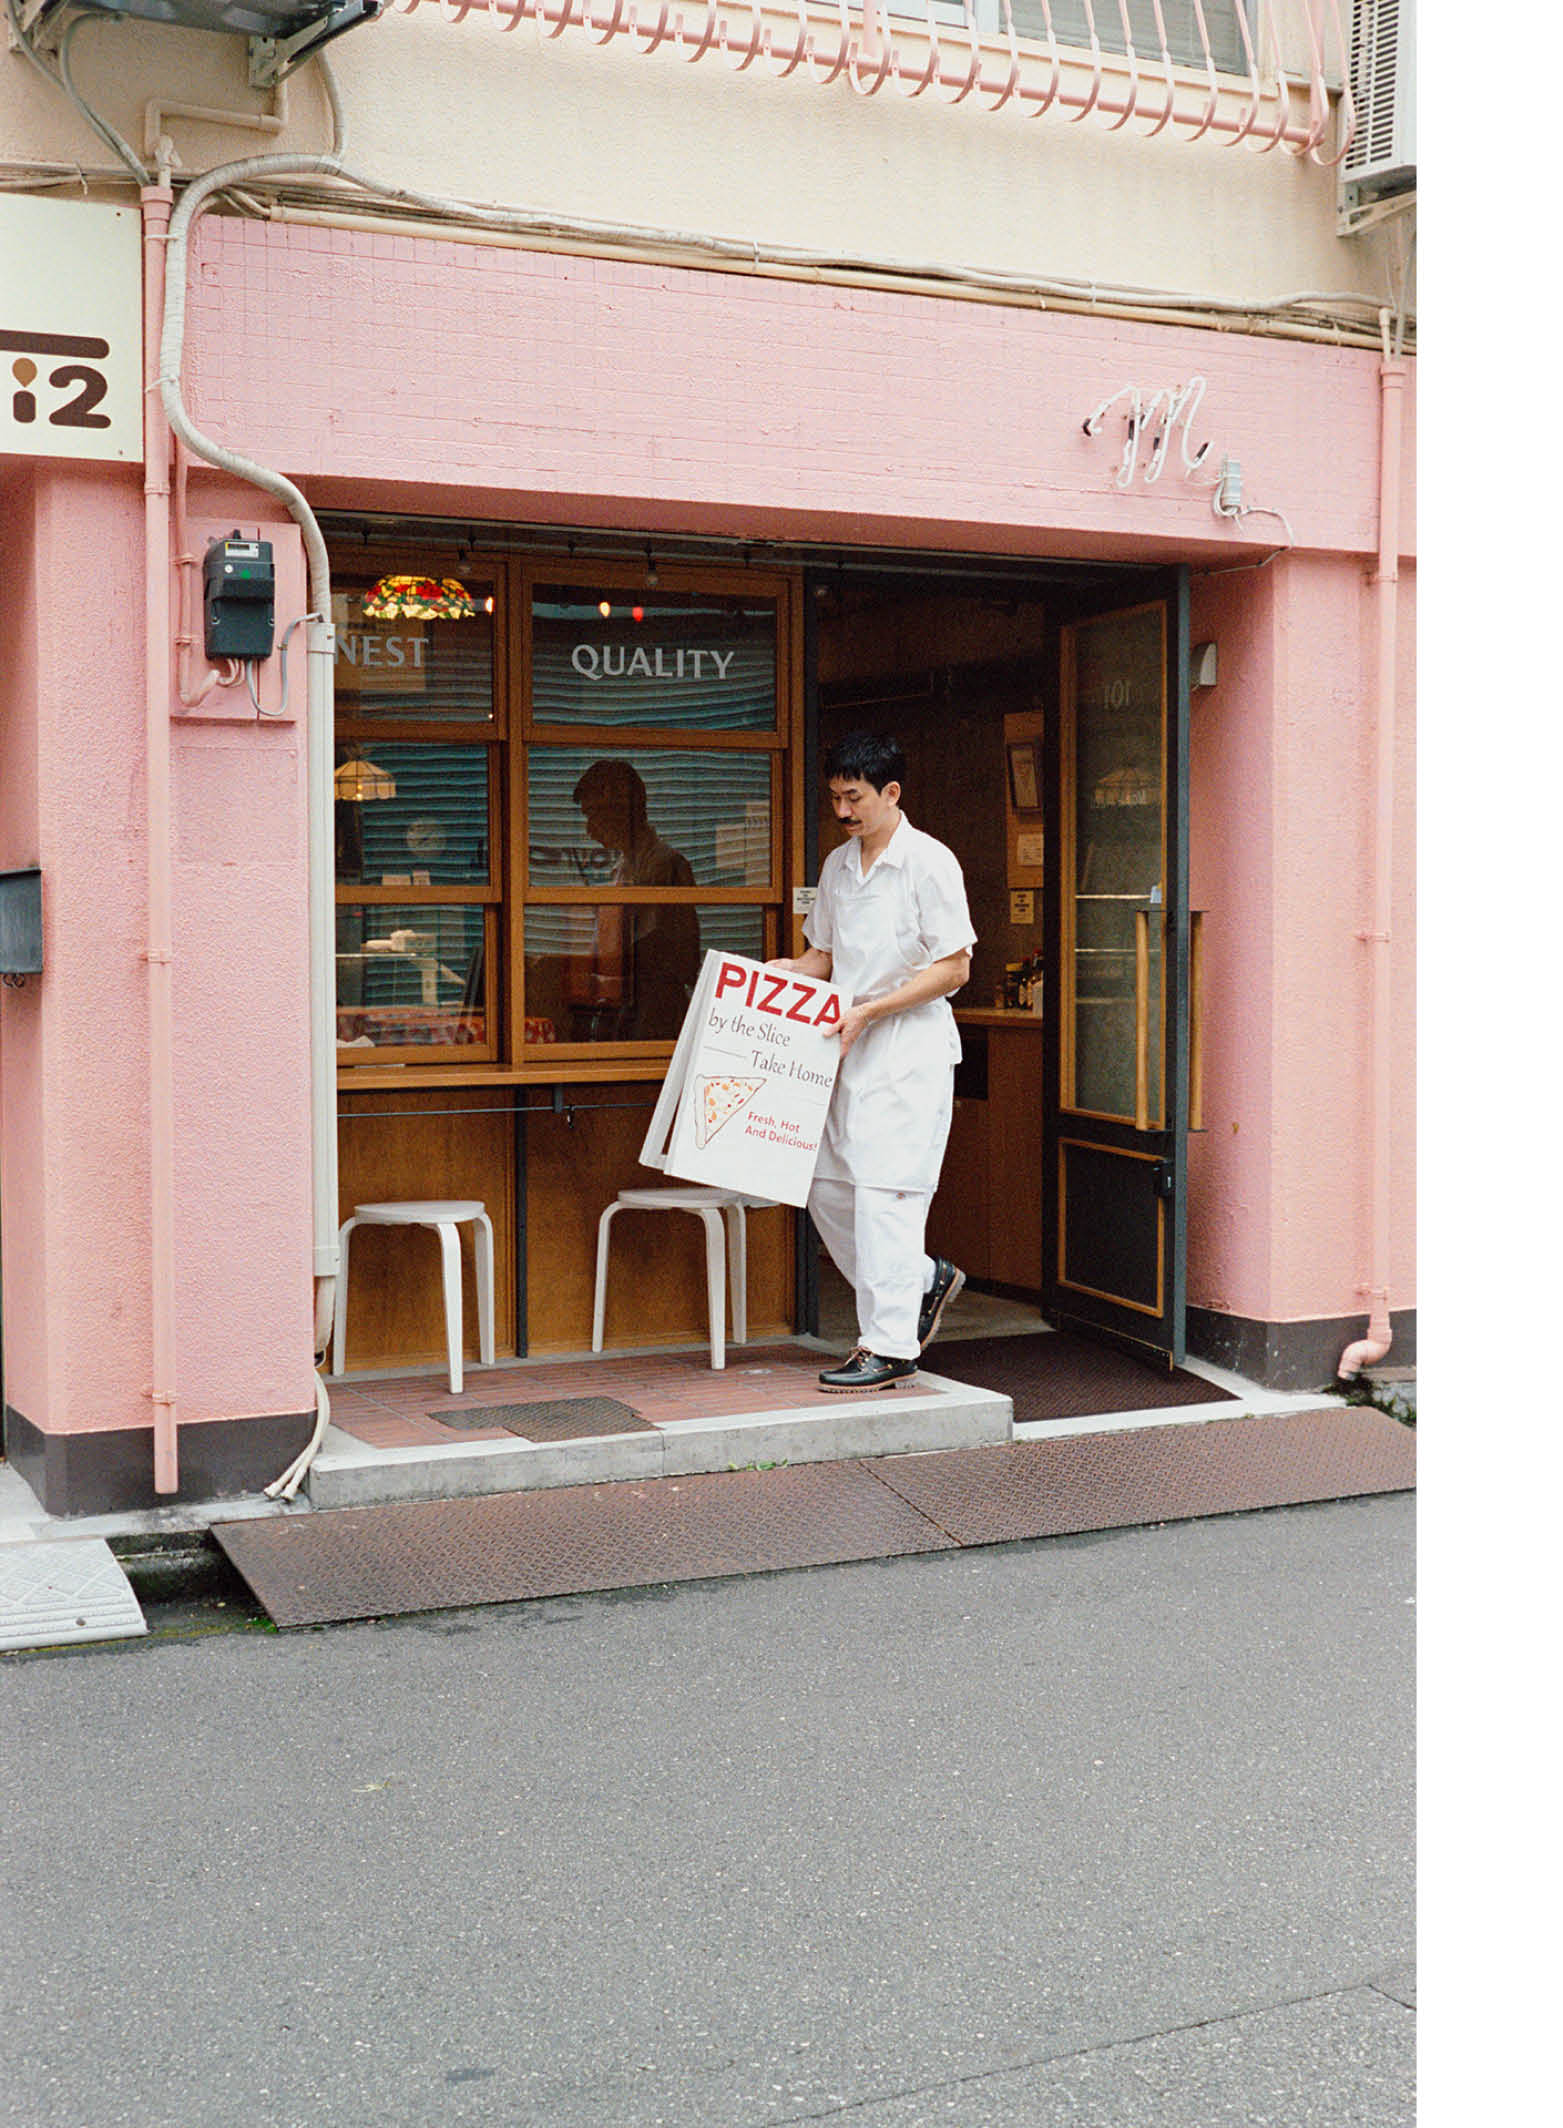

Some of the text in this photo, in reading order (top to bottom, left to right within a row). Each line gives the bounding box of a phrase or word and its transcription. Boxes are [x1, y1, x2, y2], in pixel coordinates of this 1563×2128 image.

[571, 643, 734, 680] QUALITY
[715, 961, 841, 1027] PIZZA
[708, 1008, 791, 1047] by the Slice
[752, 1049, 833, 1087] Take Home
[745, 1125, 818, 1151] And Delicious!
[780, 1120, 801, 1133] Hot
